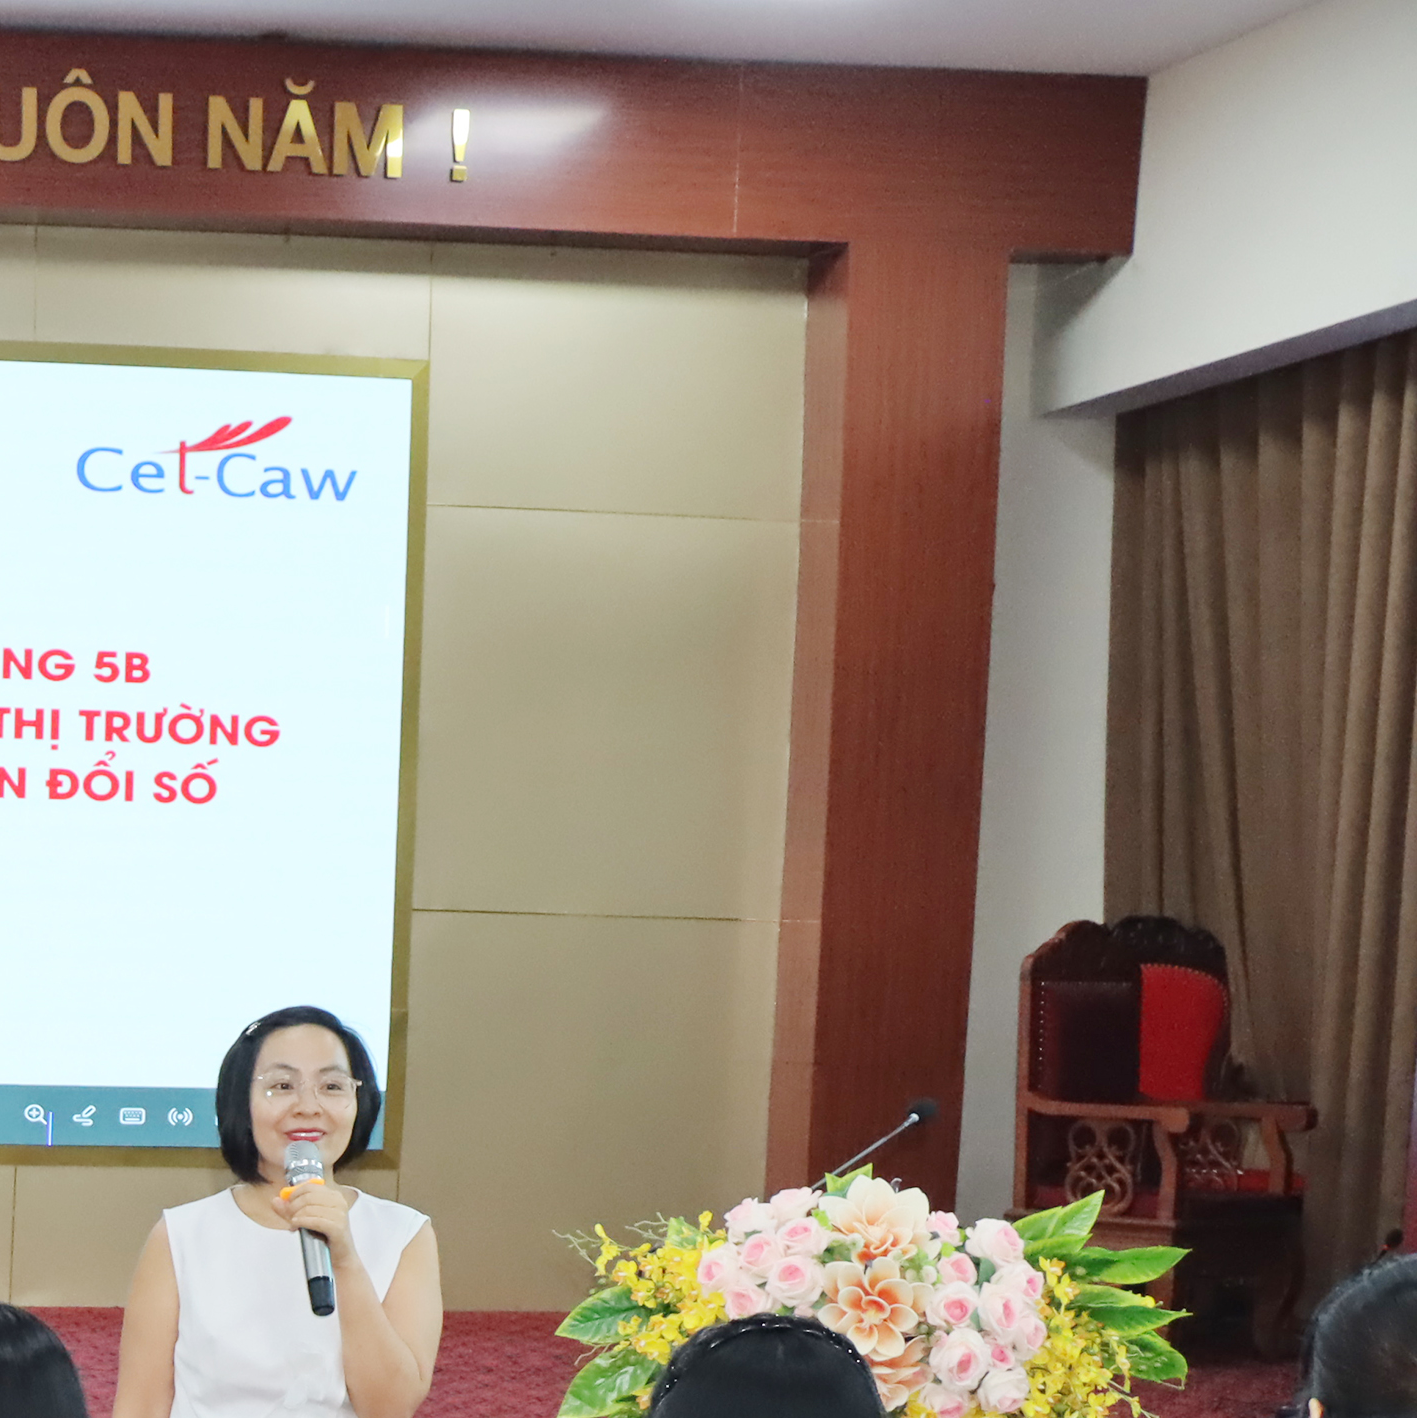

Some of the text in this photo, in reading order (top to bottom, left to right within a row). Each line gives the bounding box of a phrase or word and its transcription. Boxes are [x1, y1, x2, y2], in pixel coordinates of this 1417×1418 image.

[207, 76, 403, 178] NĂM
[451, 108, 471, 182] !
[76, 417, 358, 502] Cet-Caw
[93, 650, 151, 684] 5B
[78, 703, 280, 748] TRƯỜNG
[46, 751, 135, 802] ĐỔI
[152, 757, 218, 805] SỐ
